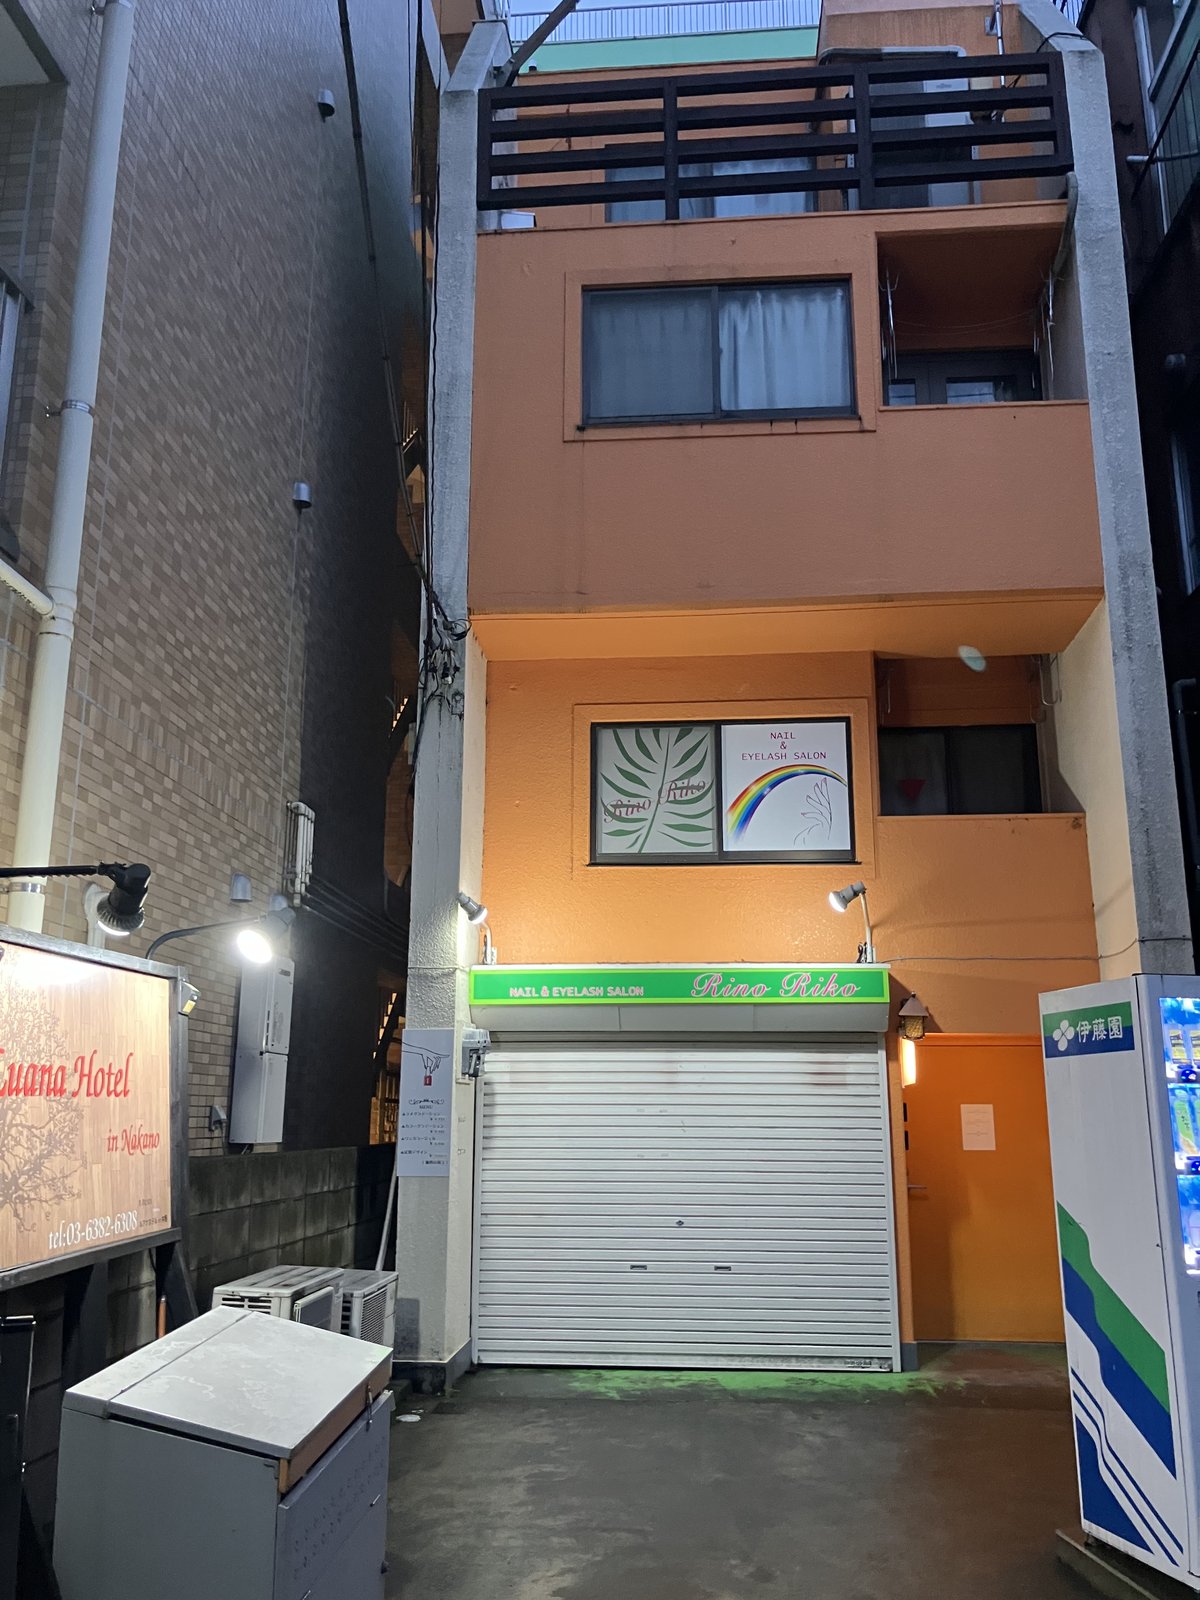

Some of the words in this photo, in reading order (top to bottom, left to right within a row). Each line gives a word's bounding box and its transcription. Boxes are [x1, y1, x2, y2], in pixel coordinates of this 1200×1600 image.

[770, 732, 797, 740] NAIL
[779, 741, 788, 750] &
[741, 752, 788, 761] EYELASH
[793, 751, 827, 760] SALON
[509, 987, 539, 998] NAIL
[540, 985, 550, 998] &
[552, 986, 604, 997] EYELASH
[606, 986, 645, 997] SALON
[691, 972, 771, 998] Rino
[779, 972, 861, 998] Riko
[1076, 1016, 1123, 1043] 伊藤園
[71, 1049, 133, 1098] Hotel
[106, 1128, 119, 1153] in
[121, 1124, 160, 1156] Nakano
[48, 1209, 138, 1250] tel:03-6382-6308
